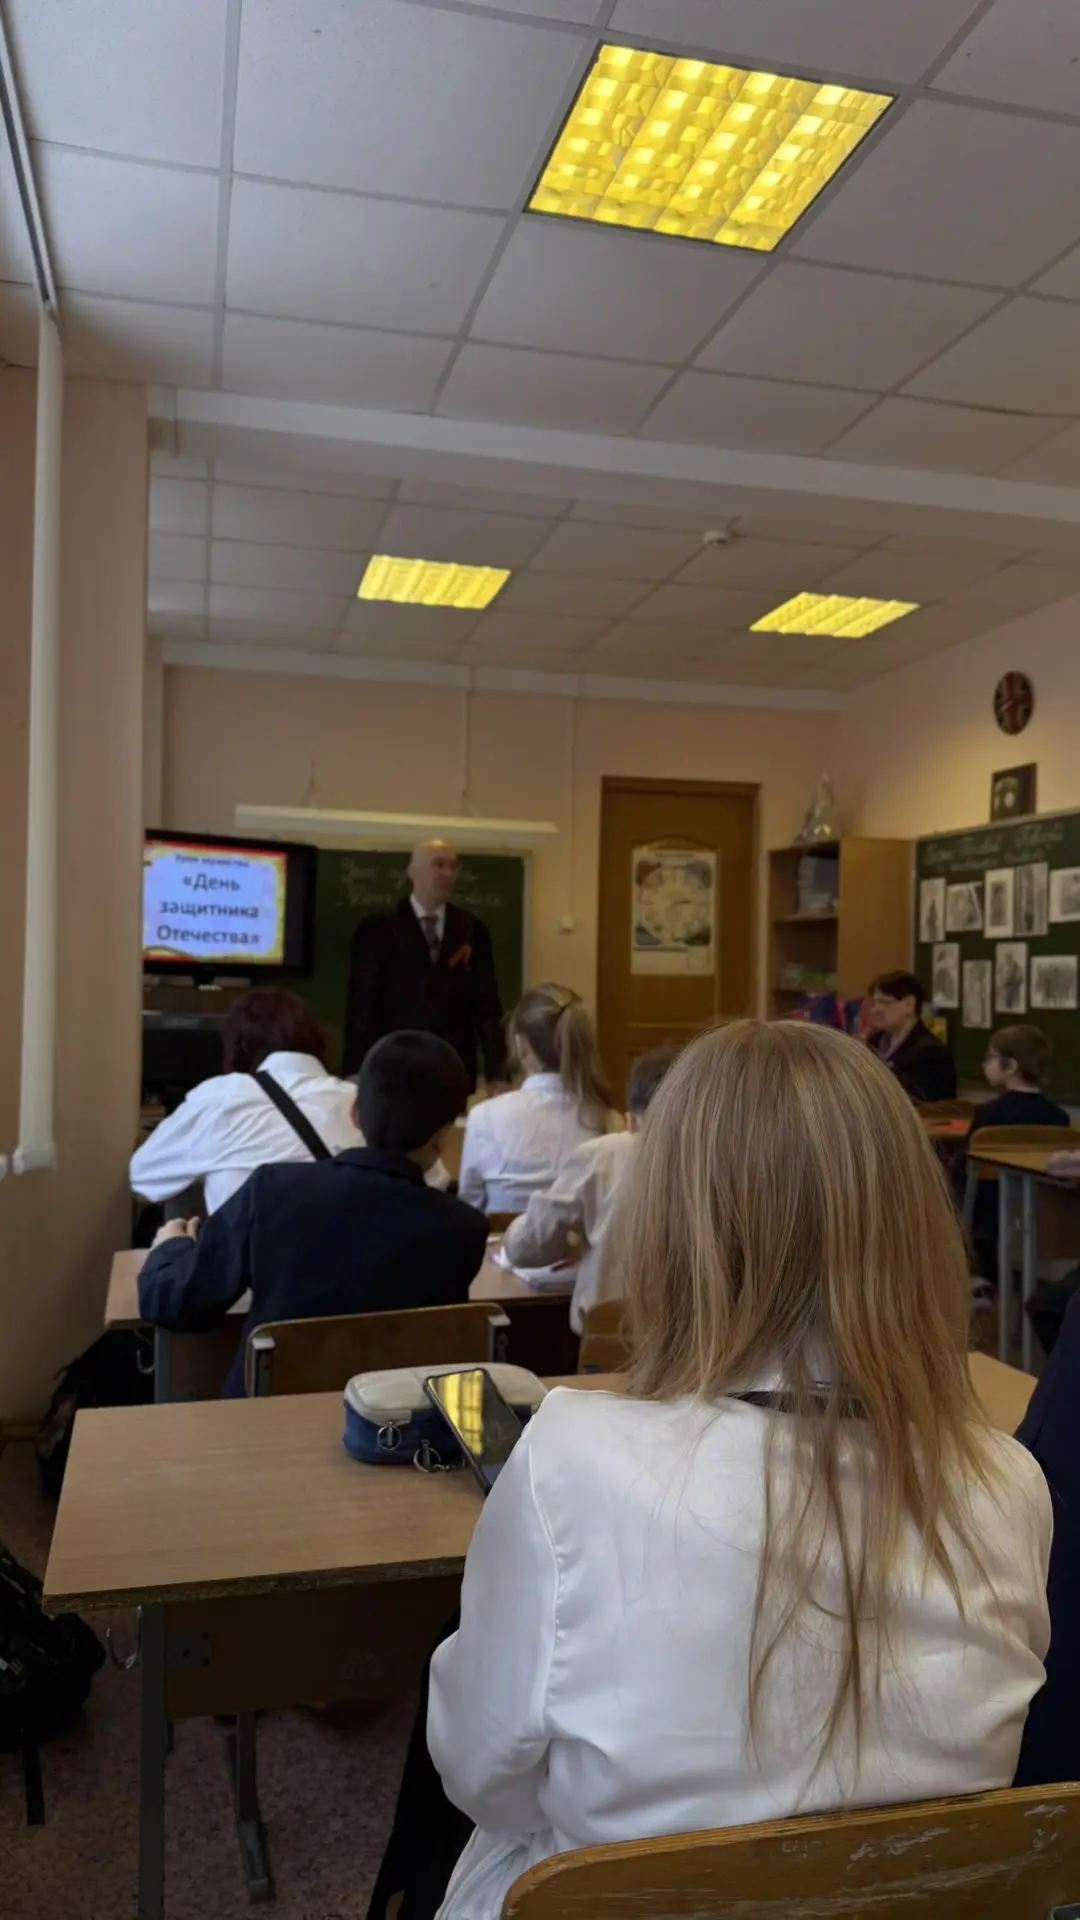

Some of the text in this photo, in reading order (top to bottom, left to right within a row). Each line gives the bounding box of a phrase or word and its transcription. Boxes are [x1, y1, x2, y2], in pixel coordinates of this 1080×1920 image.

[183, 873, 240, 892] «День
[160, 901, 259, 918] защитника
[157, 925, 260, 945] Отечества»
